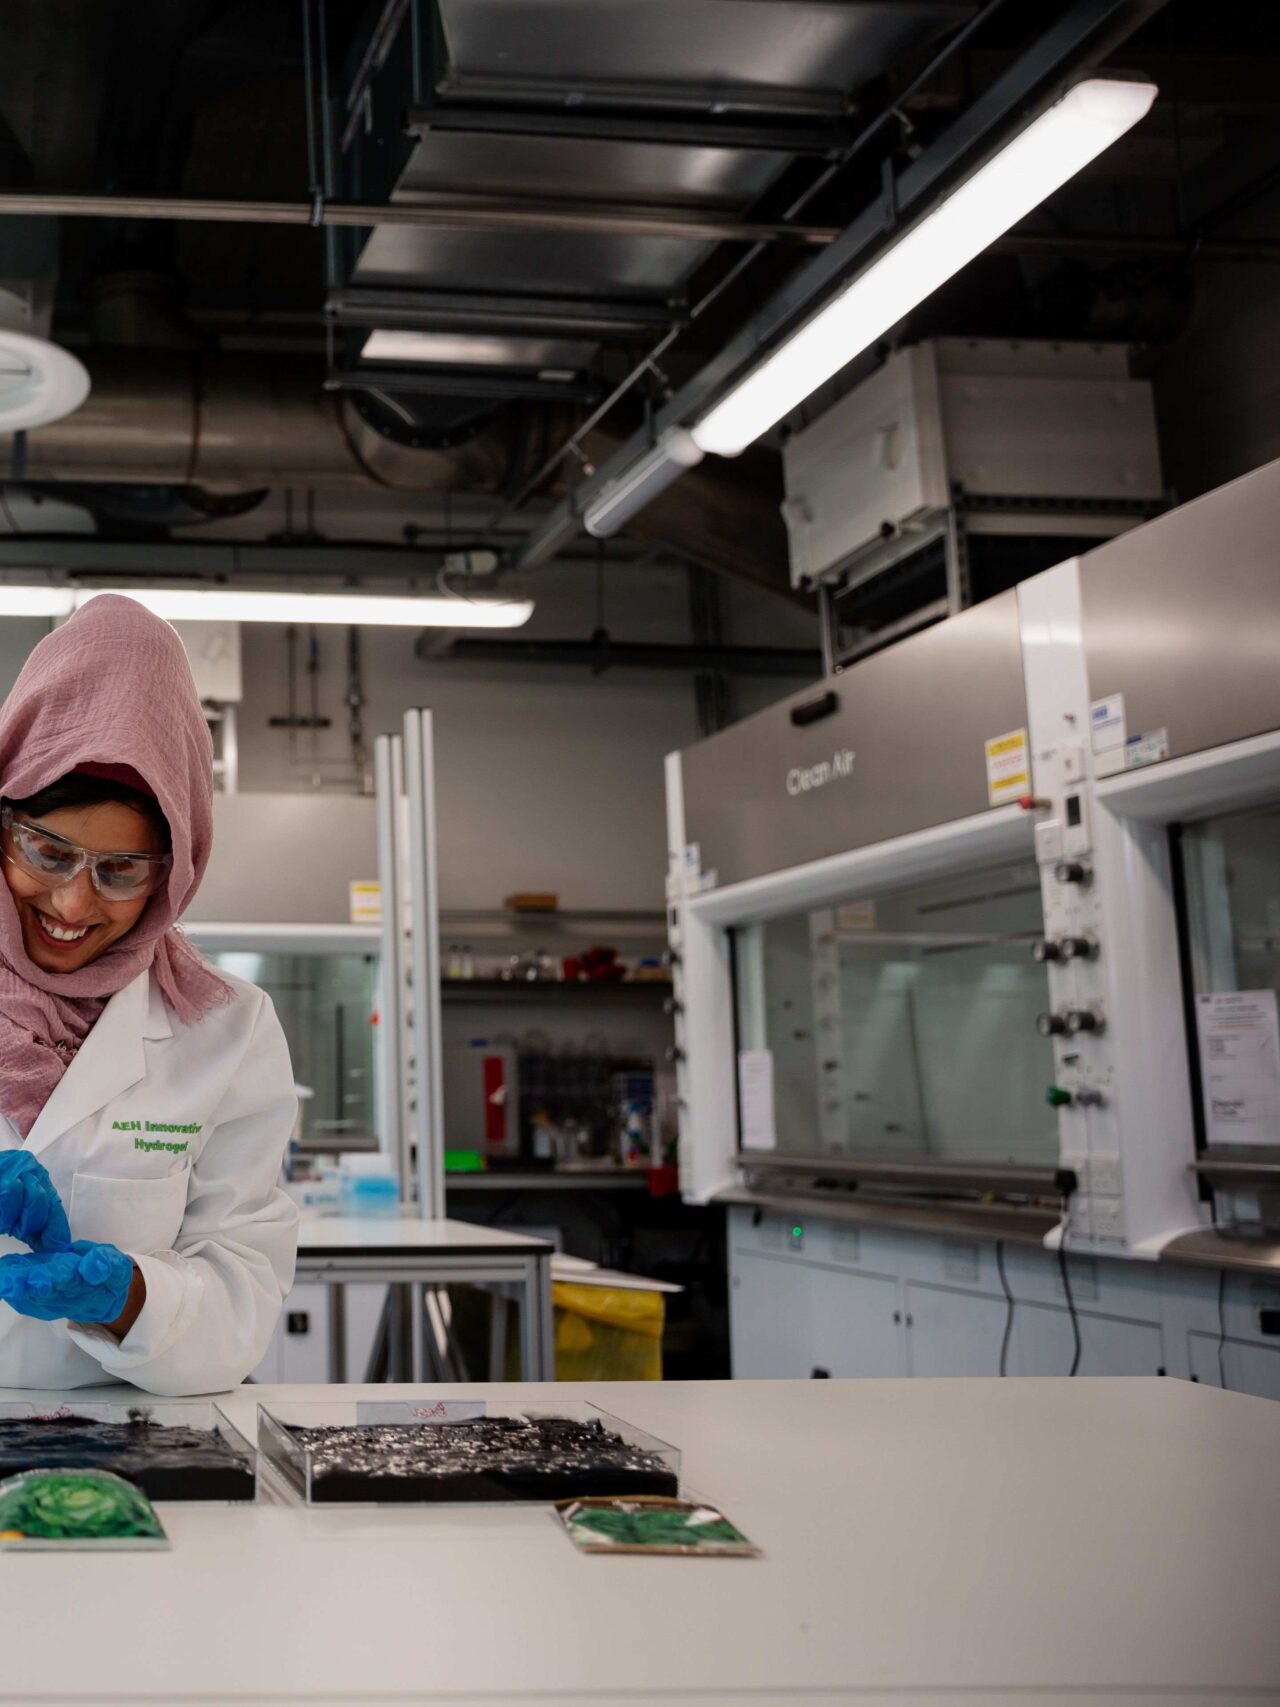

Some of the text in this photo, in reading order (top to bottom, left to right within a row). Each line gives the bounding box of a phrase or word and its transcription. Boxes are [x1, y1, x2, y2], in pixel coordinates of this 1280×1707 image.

[831, 748, 856, 780] Air
[111, 1120, 202, 1134] AEH Innovativ
